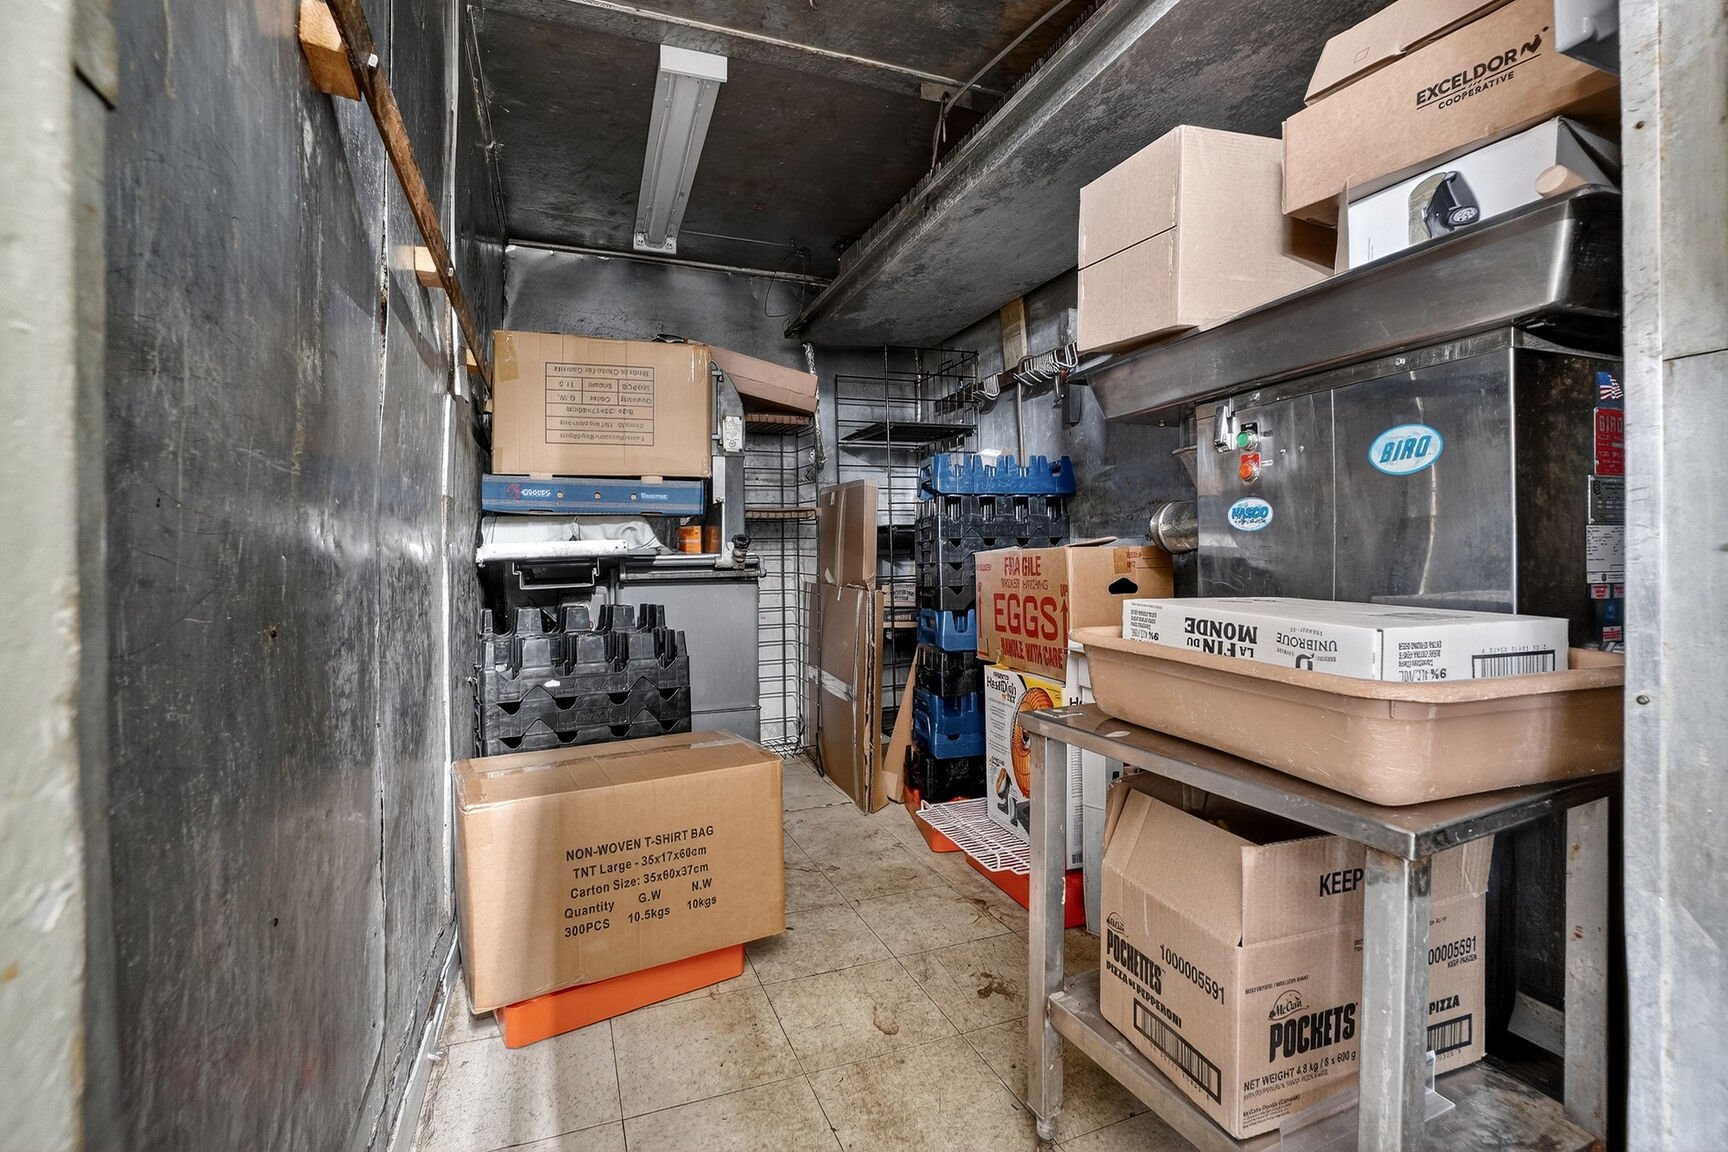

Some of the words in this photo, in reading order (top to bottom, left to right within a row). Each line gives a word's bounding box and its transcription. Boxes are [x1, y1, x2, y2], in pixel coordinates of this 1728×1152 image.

[1416, 48, 1518, 106] EXCELDOR
[1438, 71, 1514, 109] COOPERATIVE
[1380, 434, 1432, 464] BIRO
[1004, 556, 1042, 576] FRAGILE
[993, 593, 1058, 641] EGGS
[1184, 616, 1258, 644] MONDE
[1186, 636, 1200, 648] DU
[1202, 638, 1236, 658] FIN
[1239, 646, 1254, 658] LA
[1275, 632, 1338, 652] UNIBROUE
[1431, 668, 1447, 679] 9%
[566, 838, 641, 862] NON-WOVEN
[644, 829, 688, 848] T-SHIRT
[691, 825, 714, 840] BAG
[573, 865, 597, 880] TNT
[600, 859, 632, 875] Large
[1319, 868, 1364, 897] KEEP
[564, 901, 615, 920] Quantity
[638, 889, 661, 904] G.W
[691, 878, 713, 892] N.W
[570, 883, 610, 900] Carton
[613, 877, 641, 891] Size:
[564, 919, 610, 938] 300PCS
[627, 906, 671, 924] 10.5kgs
[687, 895, 717, 911] 10kgs
[1106, 929, 1162, 995] POCHETTES
[1428, 935, 1478, 965] 00005591
[1160, 944, 1224, 1005] 1000005591
[1428, 994, 1460, 1015] PIZZA
[1269, 1003, 1356, 1063] POCKETS
[1243, 1078, 1260, 1092] NET
[1262, 1067, 1294, 1086] WEIGHT
